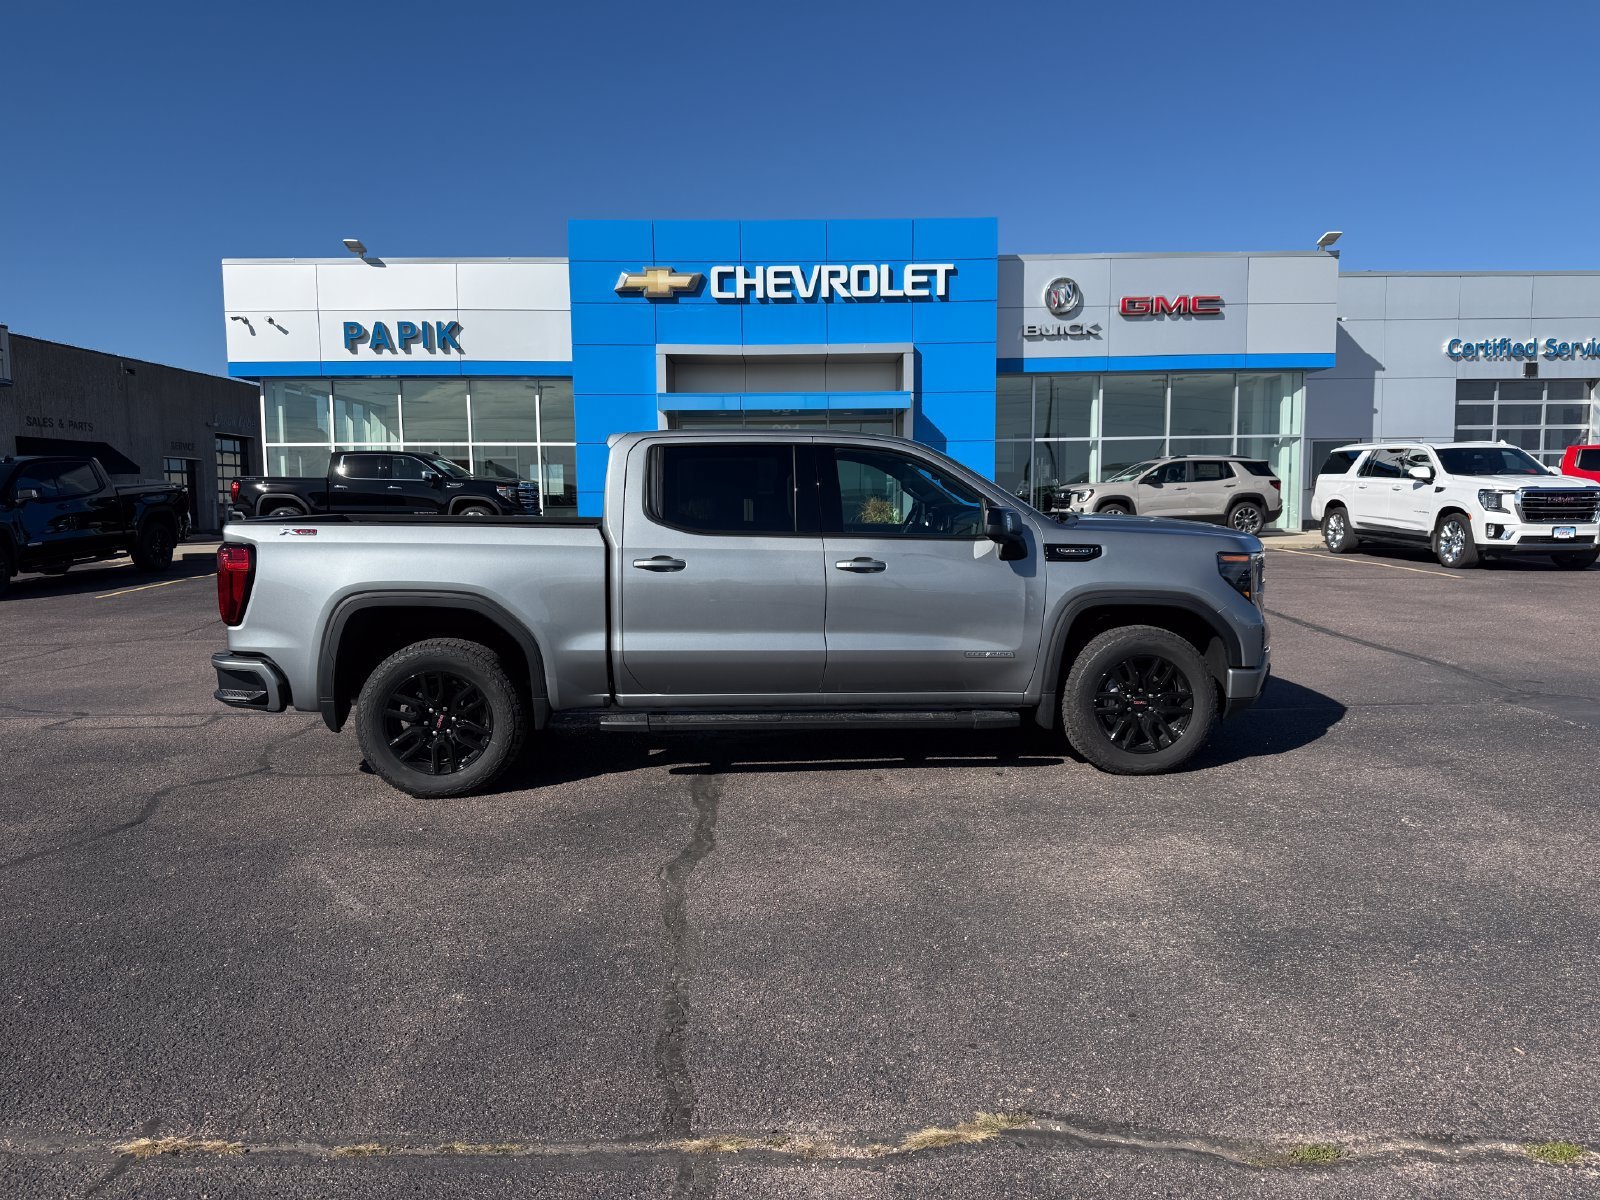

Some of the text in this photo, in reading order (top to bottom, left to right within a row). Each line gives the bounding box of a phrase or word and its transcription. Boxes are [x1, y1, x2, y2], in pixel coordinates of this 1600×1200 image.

[710, 264, 954, 299] CHEVROLET
[1119, 295, 1221, 314] GMC
[343, 321, 460, 349] PAPIK
[1023, 323, 1103, 336] BUICK
[1447, 337, 1537, 357] Certified
[25, 416, 94, 432] SALES & PARTS
